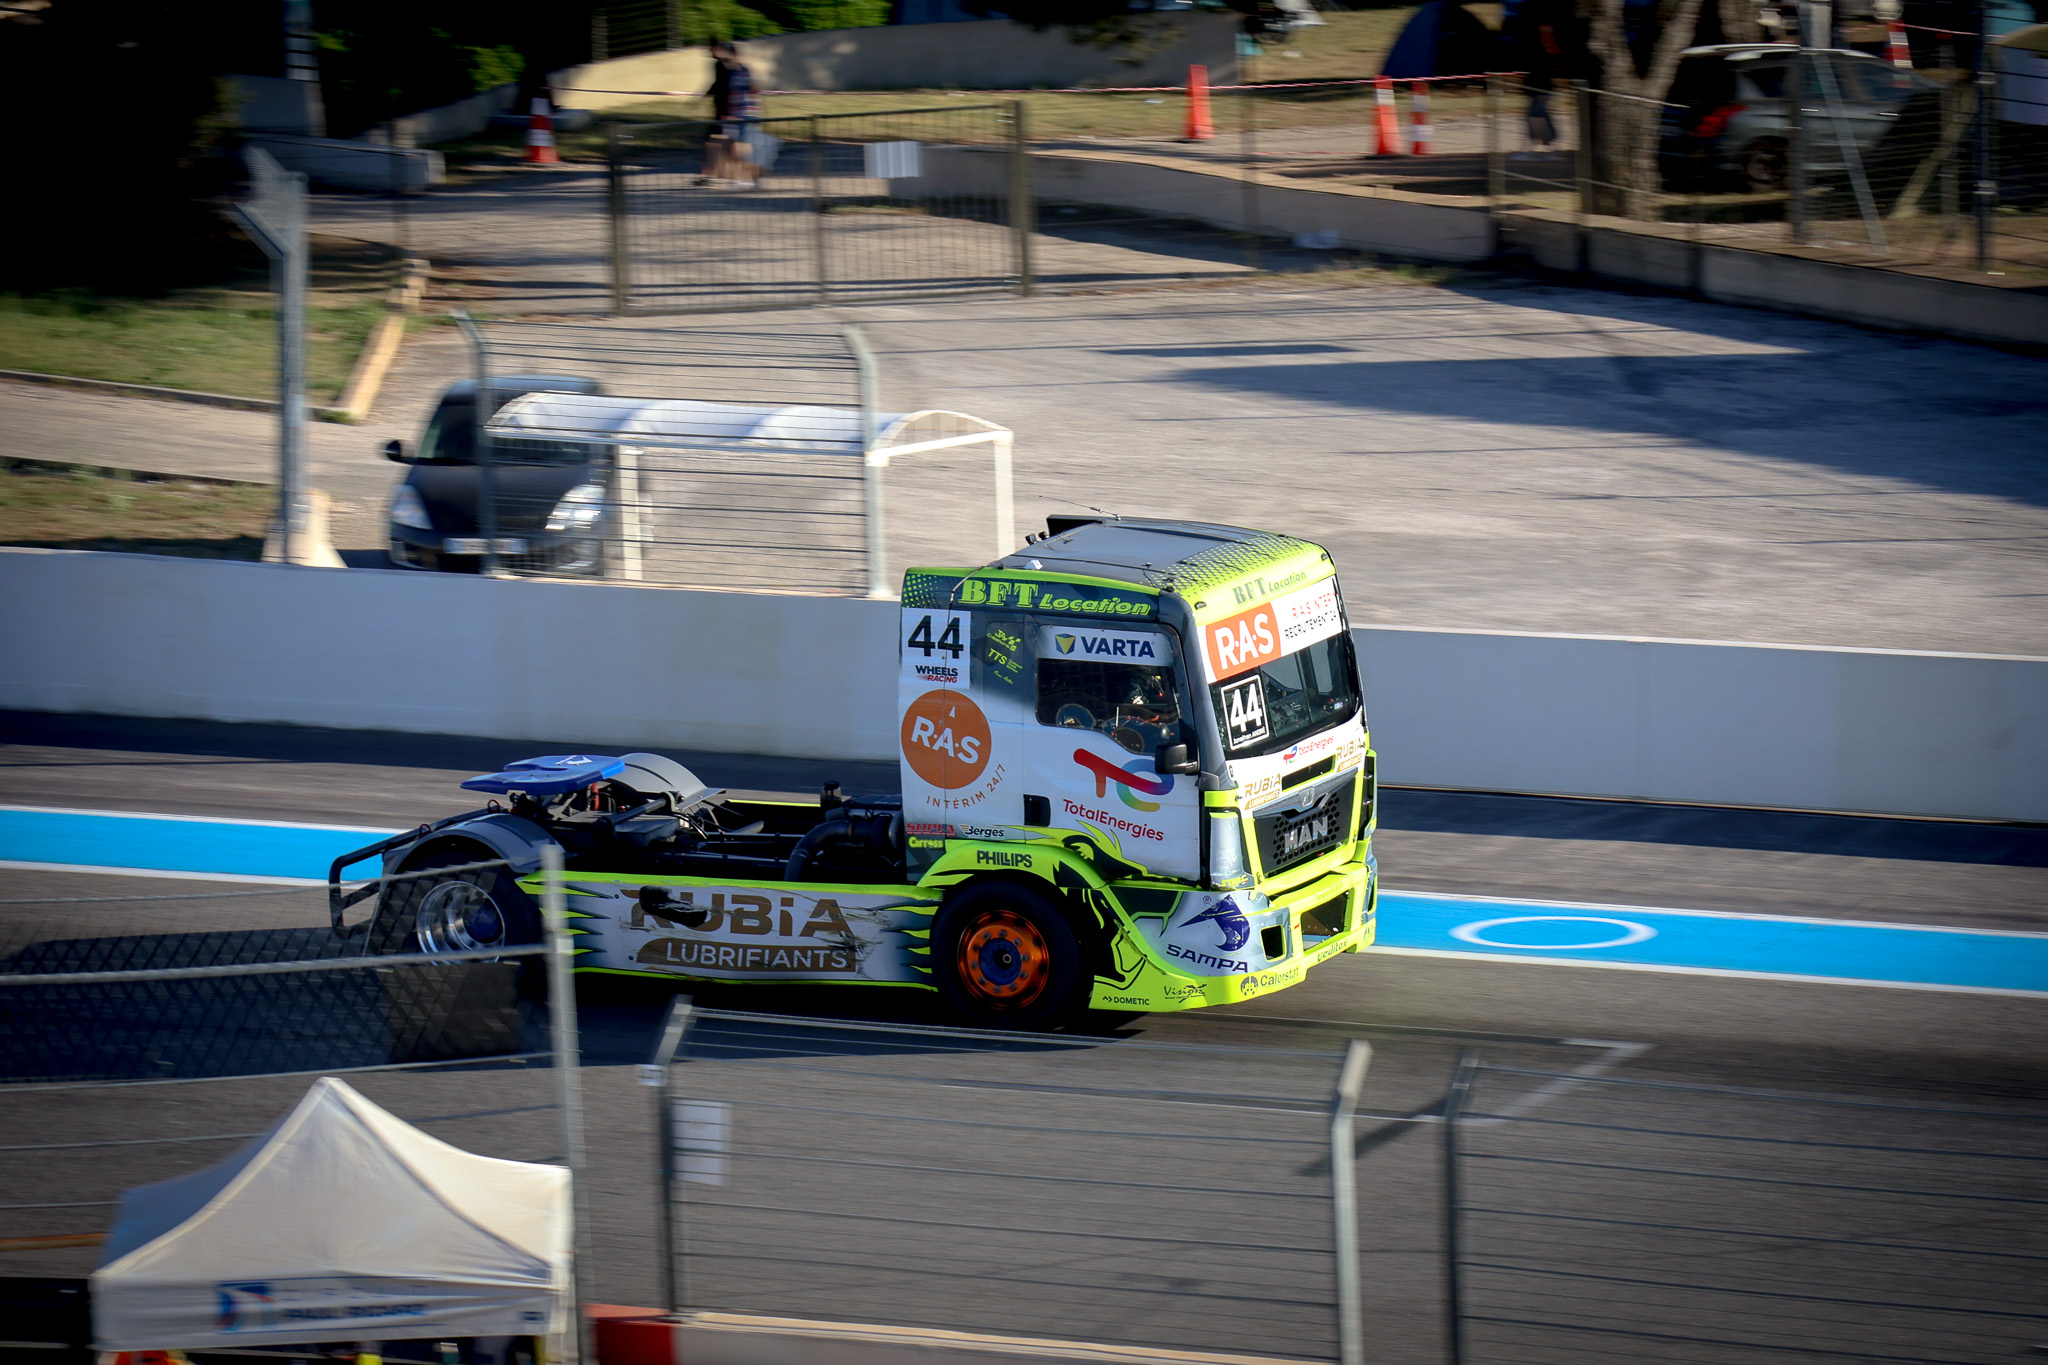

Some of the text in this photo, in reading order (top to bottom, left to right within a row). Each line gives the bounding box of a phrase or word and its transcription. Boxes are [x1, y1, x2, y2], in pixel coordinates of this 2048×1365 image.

[958, 580, 1151, 616] BFT Location
[1232, 570, 1308, 606] BFT Location
[908, 615, 964, 660] 44
[1080, 636, 1156, 658] VARTA
[988, 648, 1008, 664] TTS
[915, 664, 958, 677] WHEELS
[927, 674, 957, 684] RACING
[1230, 683, 1263, 733] 44
[926, 763, 1006, 809] INTÉRIM 24/7
[966, 826, 1004, 838] Berges
[1063, 799, 1165, 841] TotalEnergies
[1284, 816, 1328, 854] MAN
[977, 850, 1033, 868] PHILLIPS
[666, 942, 849, 969] LUBRIFIANTS
[1166, 944, 1248, 973] SAMPA
[1261, 966, 1299, 986] Calorstat
[1113, 996, 1150, 1005] DOMETIC
